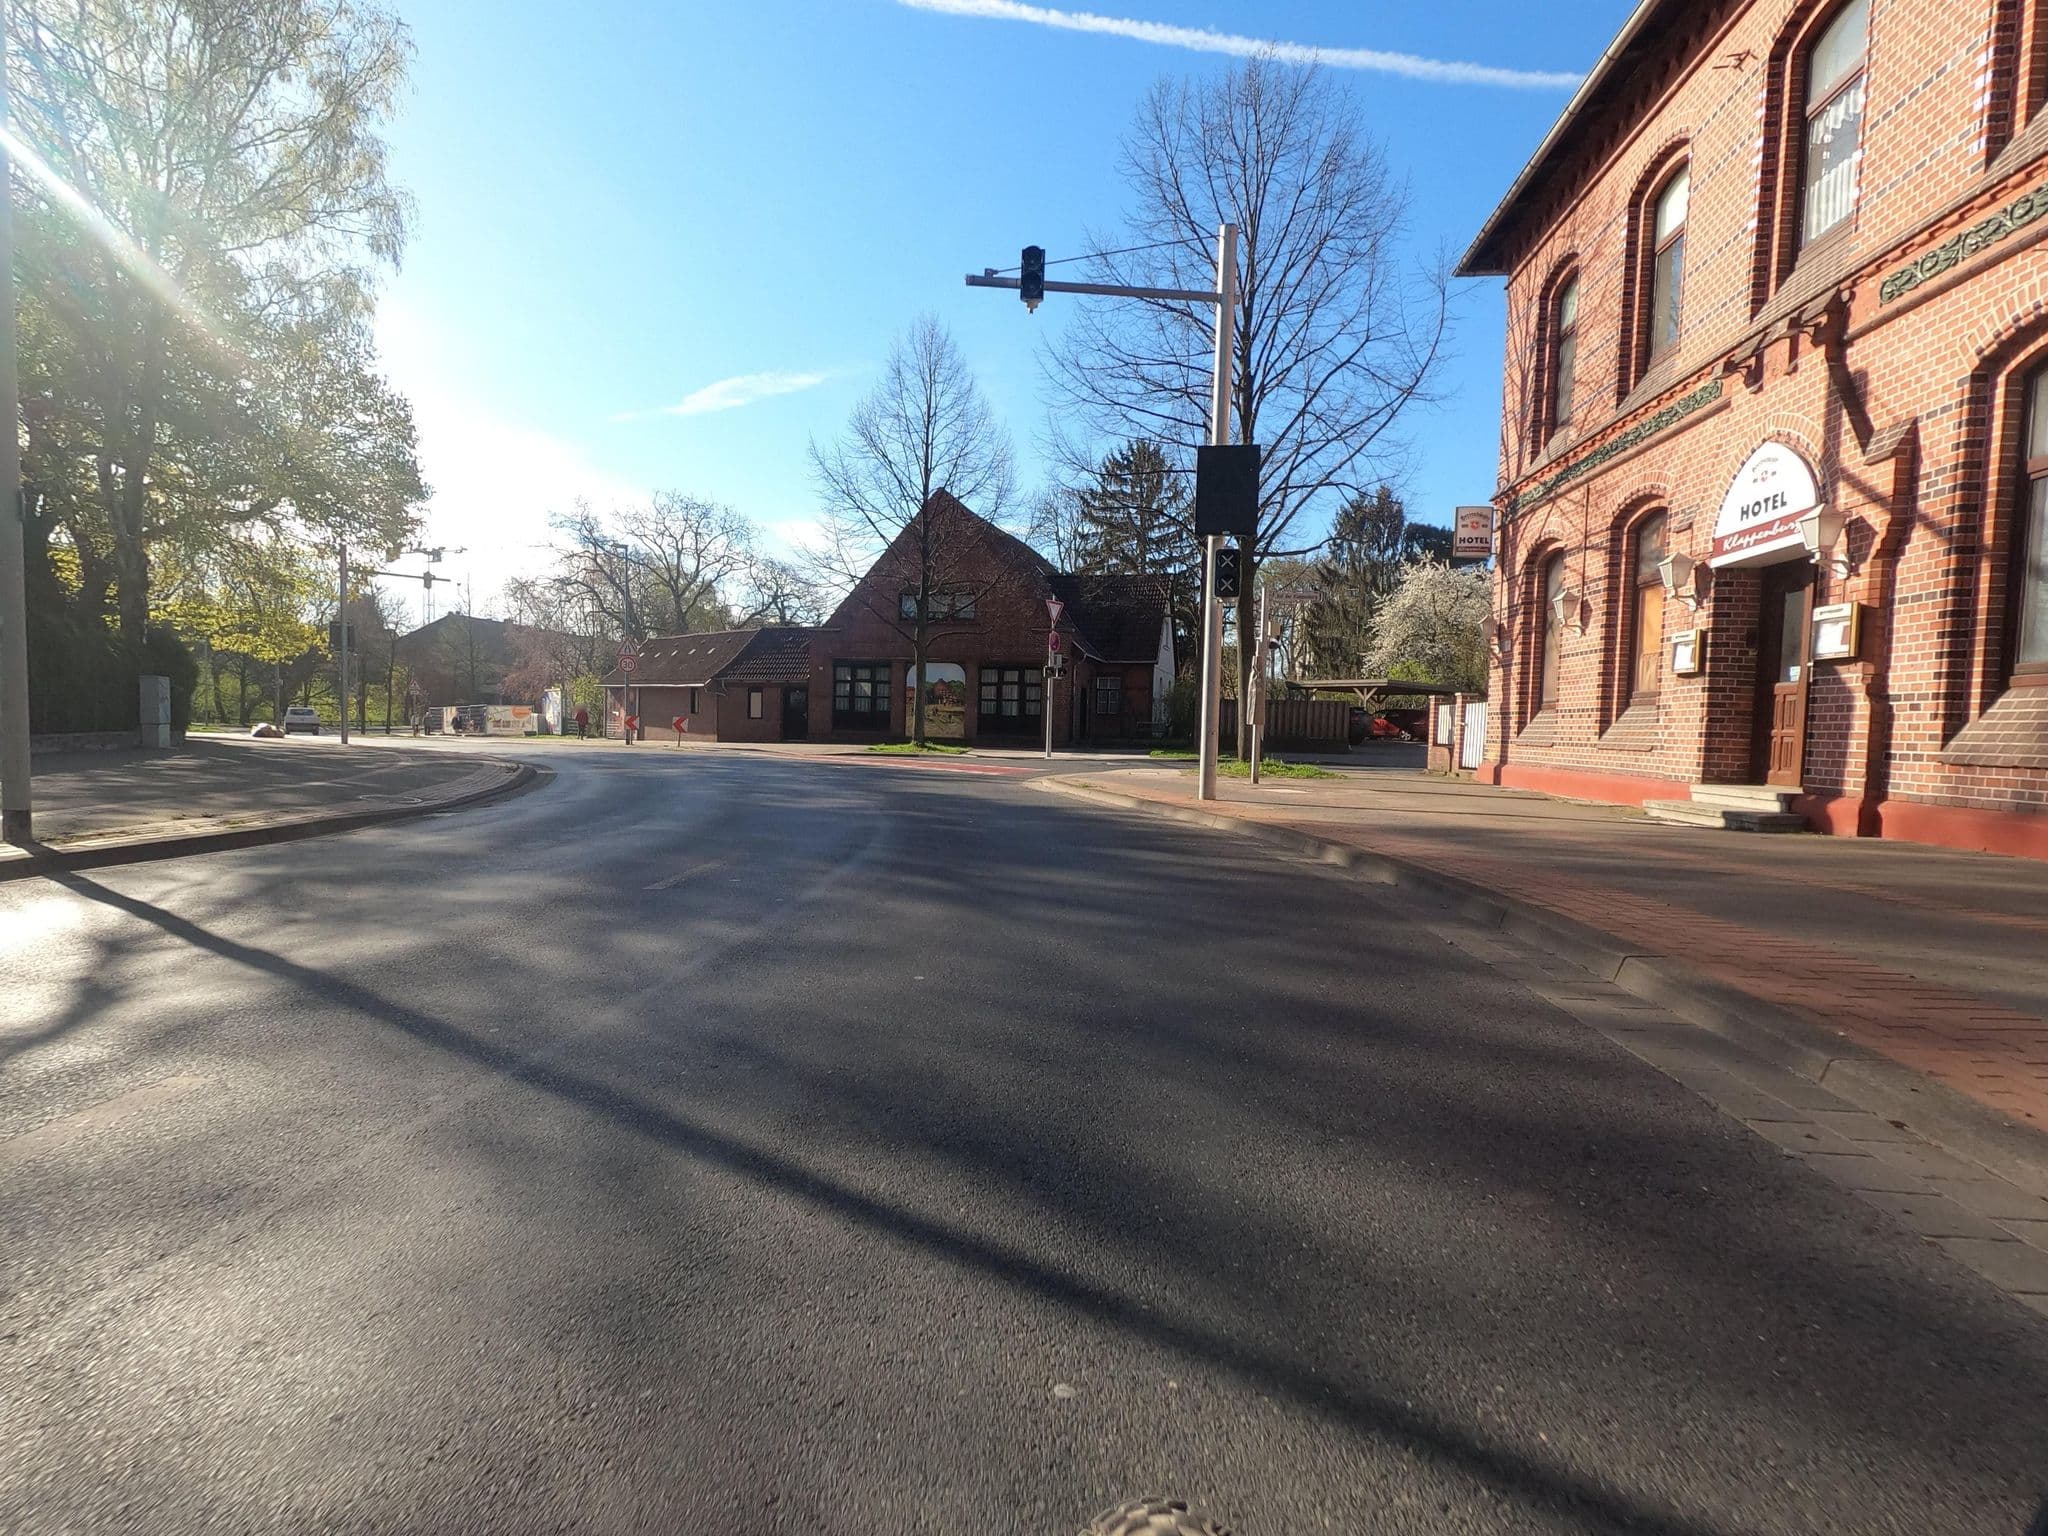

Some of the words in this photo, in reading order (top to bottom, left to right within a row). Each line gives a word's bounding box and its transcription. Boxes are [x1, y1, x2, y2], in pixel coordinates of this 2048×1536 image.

[1741, 491, 1788, 521] HOTEL
[1459, 536, 1489, 544] HOTEL
[623, 660, 634, 669] 30
